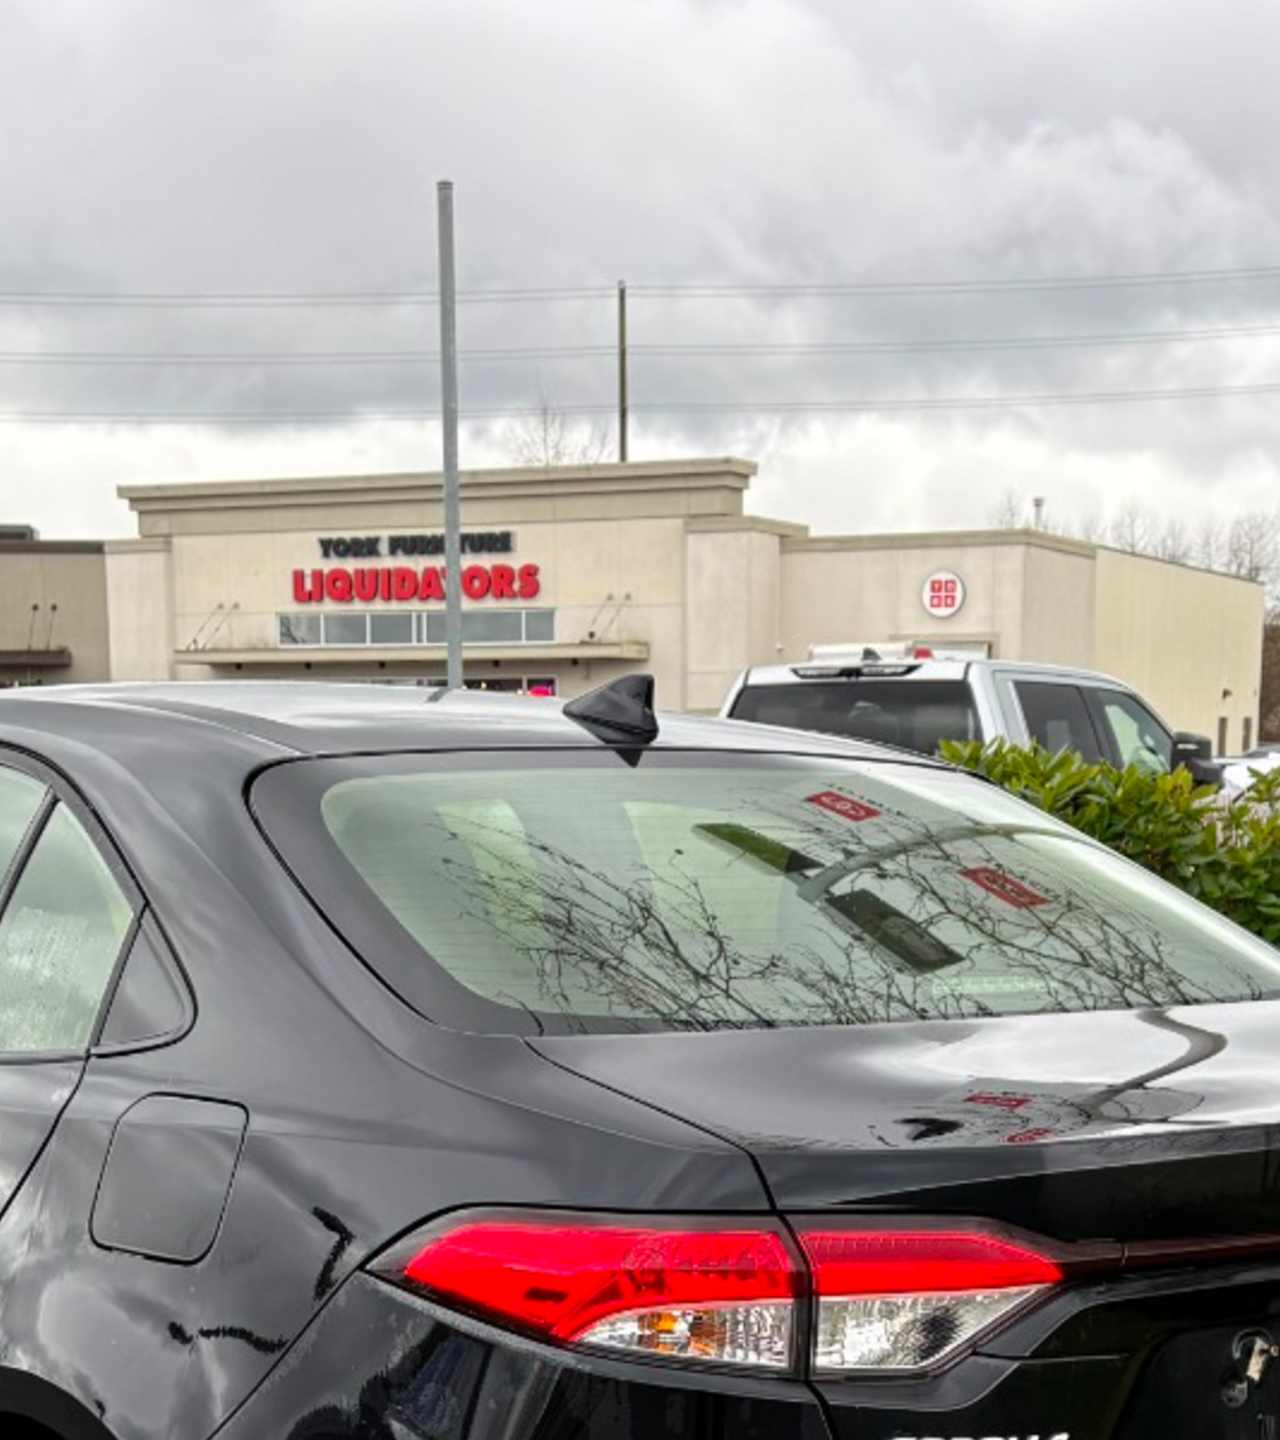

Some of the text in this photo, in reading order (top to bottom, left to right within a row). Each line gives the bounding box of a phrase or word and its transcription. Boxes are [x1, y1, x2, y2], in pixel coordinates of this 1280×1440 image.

[319, 531, 512, 558] YORK FURNTURE
[292, 563, 541, 603] LIQUIDAORS
